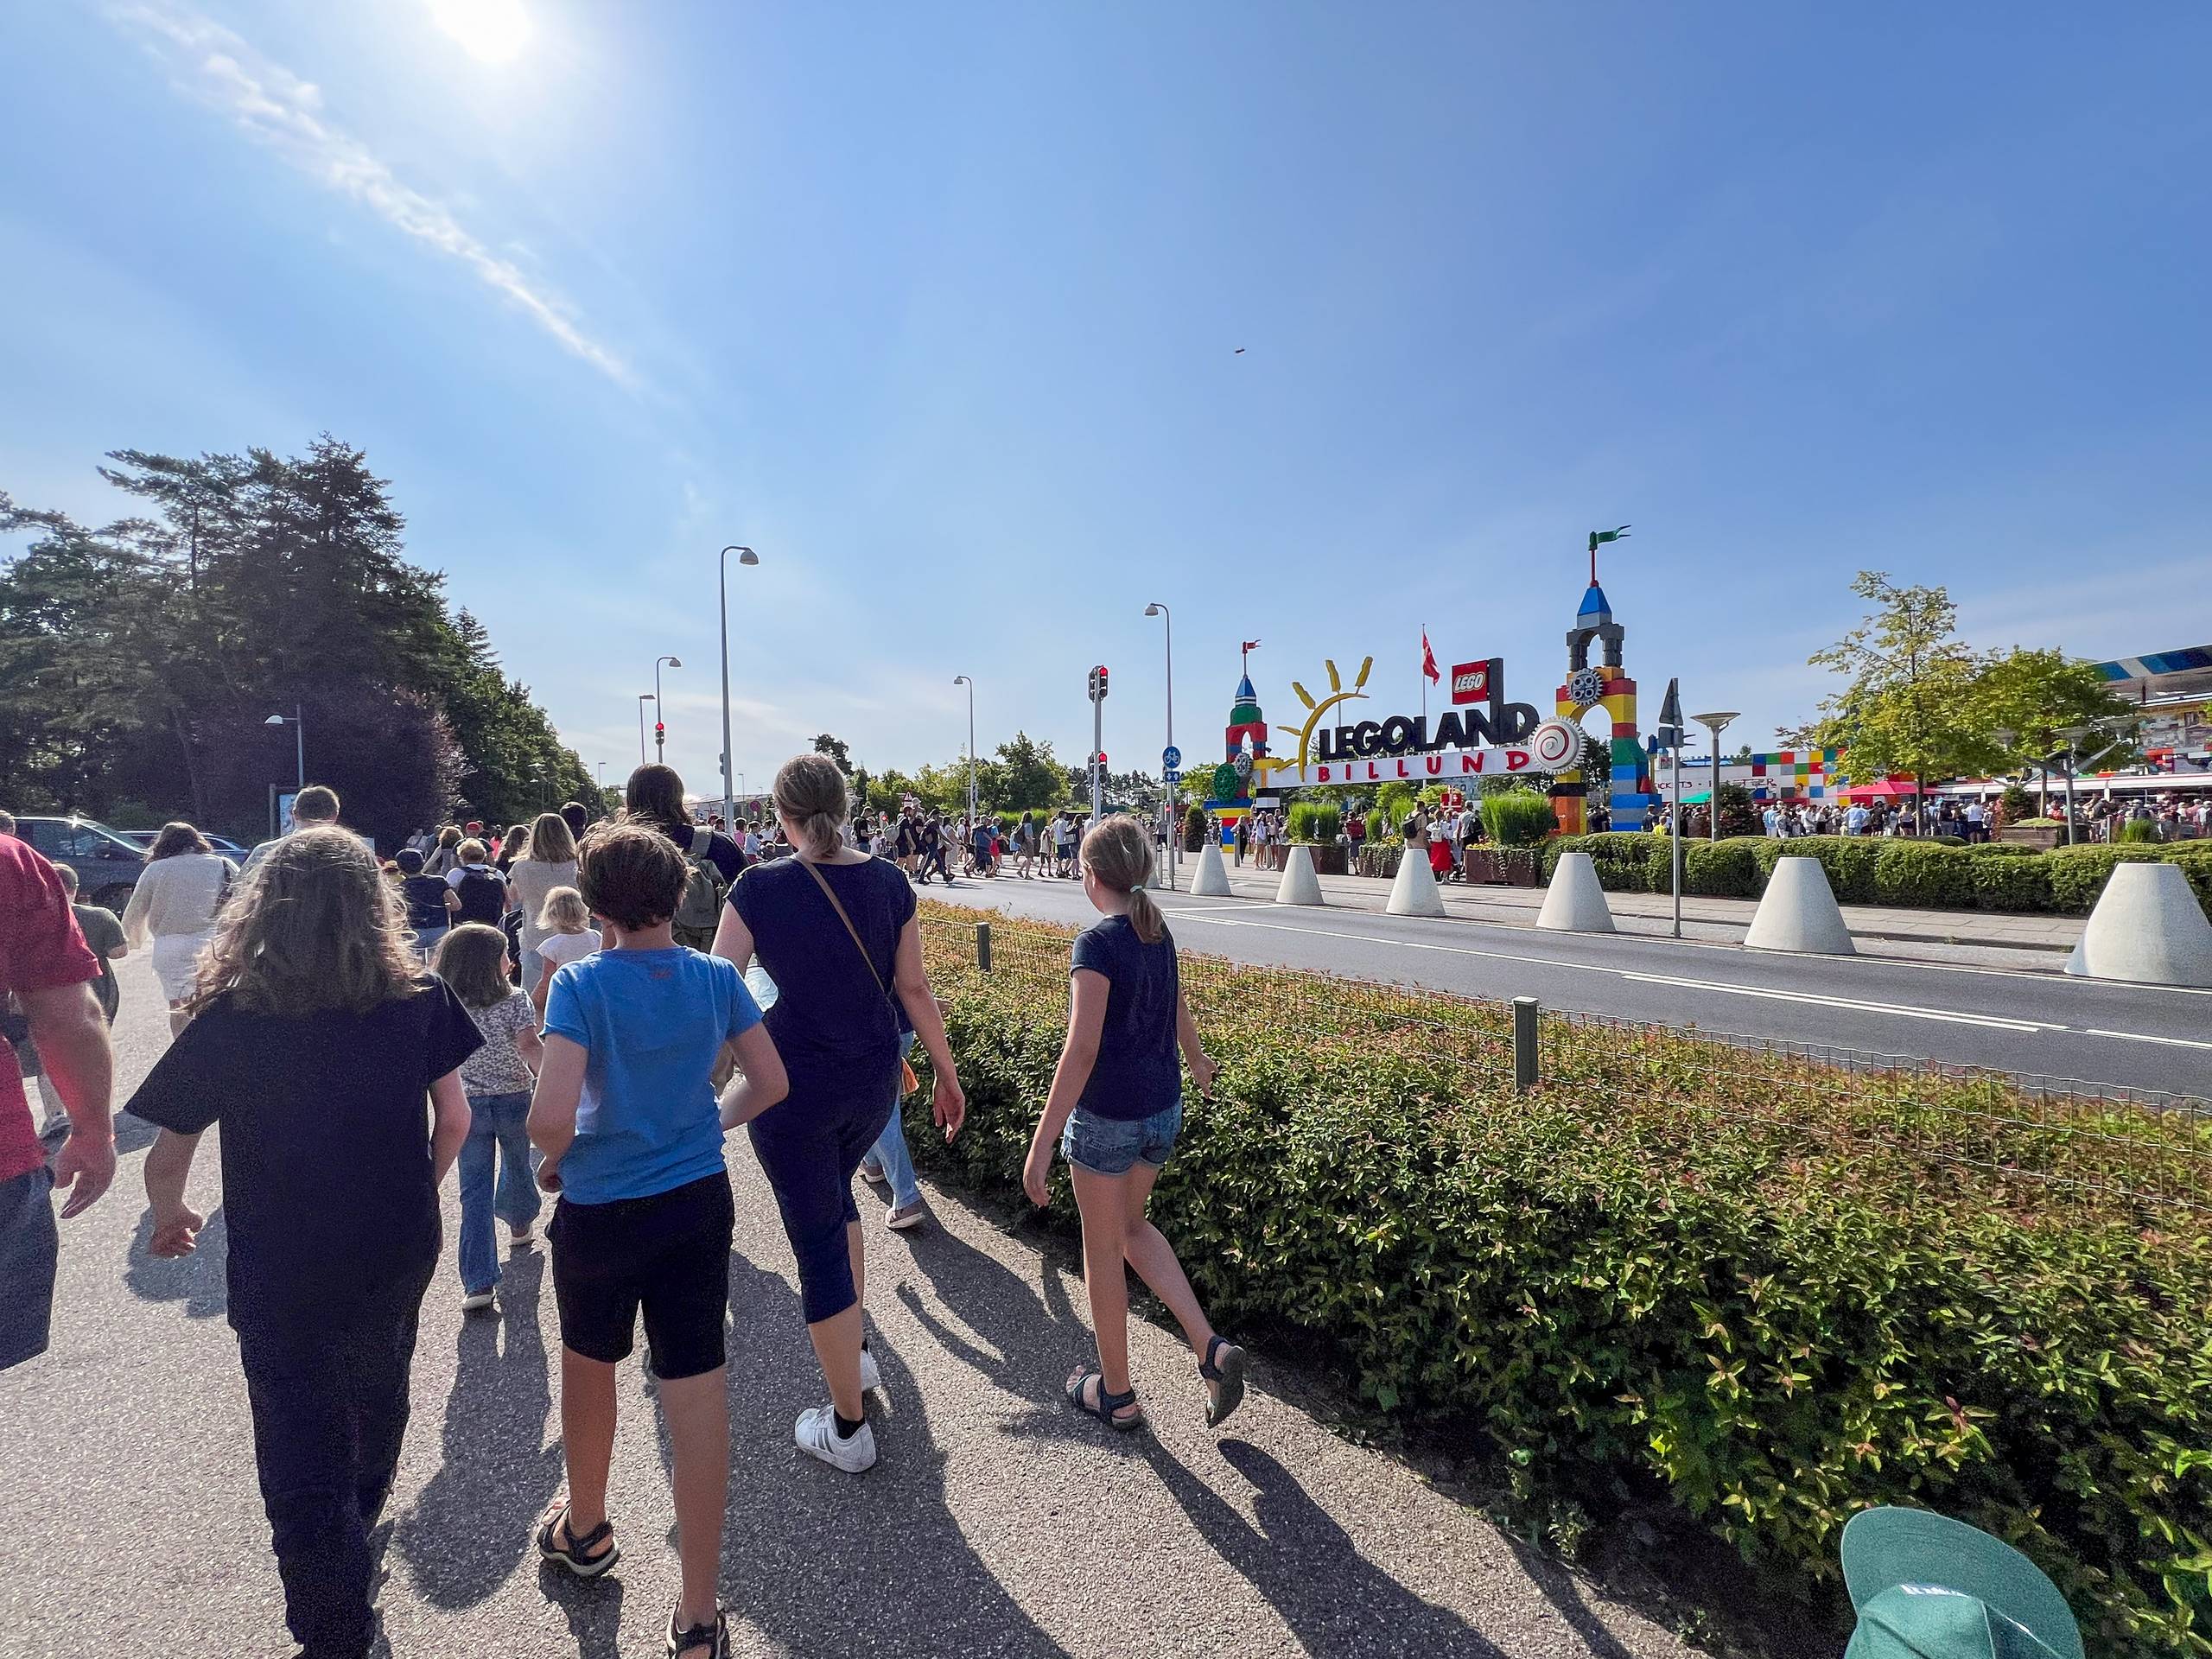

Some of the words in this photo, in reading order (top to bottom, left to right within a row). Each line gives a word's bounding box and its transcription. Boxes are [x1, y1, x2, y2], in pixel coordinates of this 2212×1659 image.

[1454, 672, 1485, 692] LEGO
[1319, 658, 1540, 760] LEGOLAND
[1318, 751, 1530, 782] BILLUND
